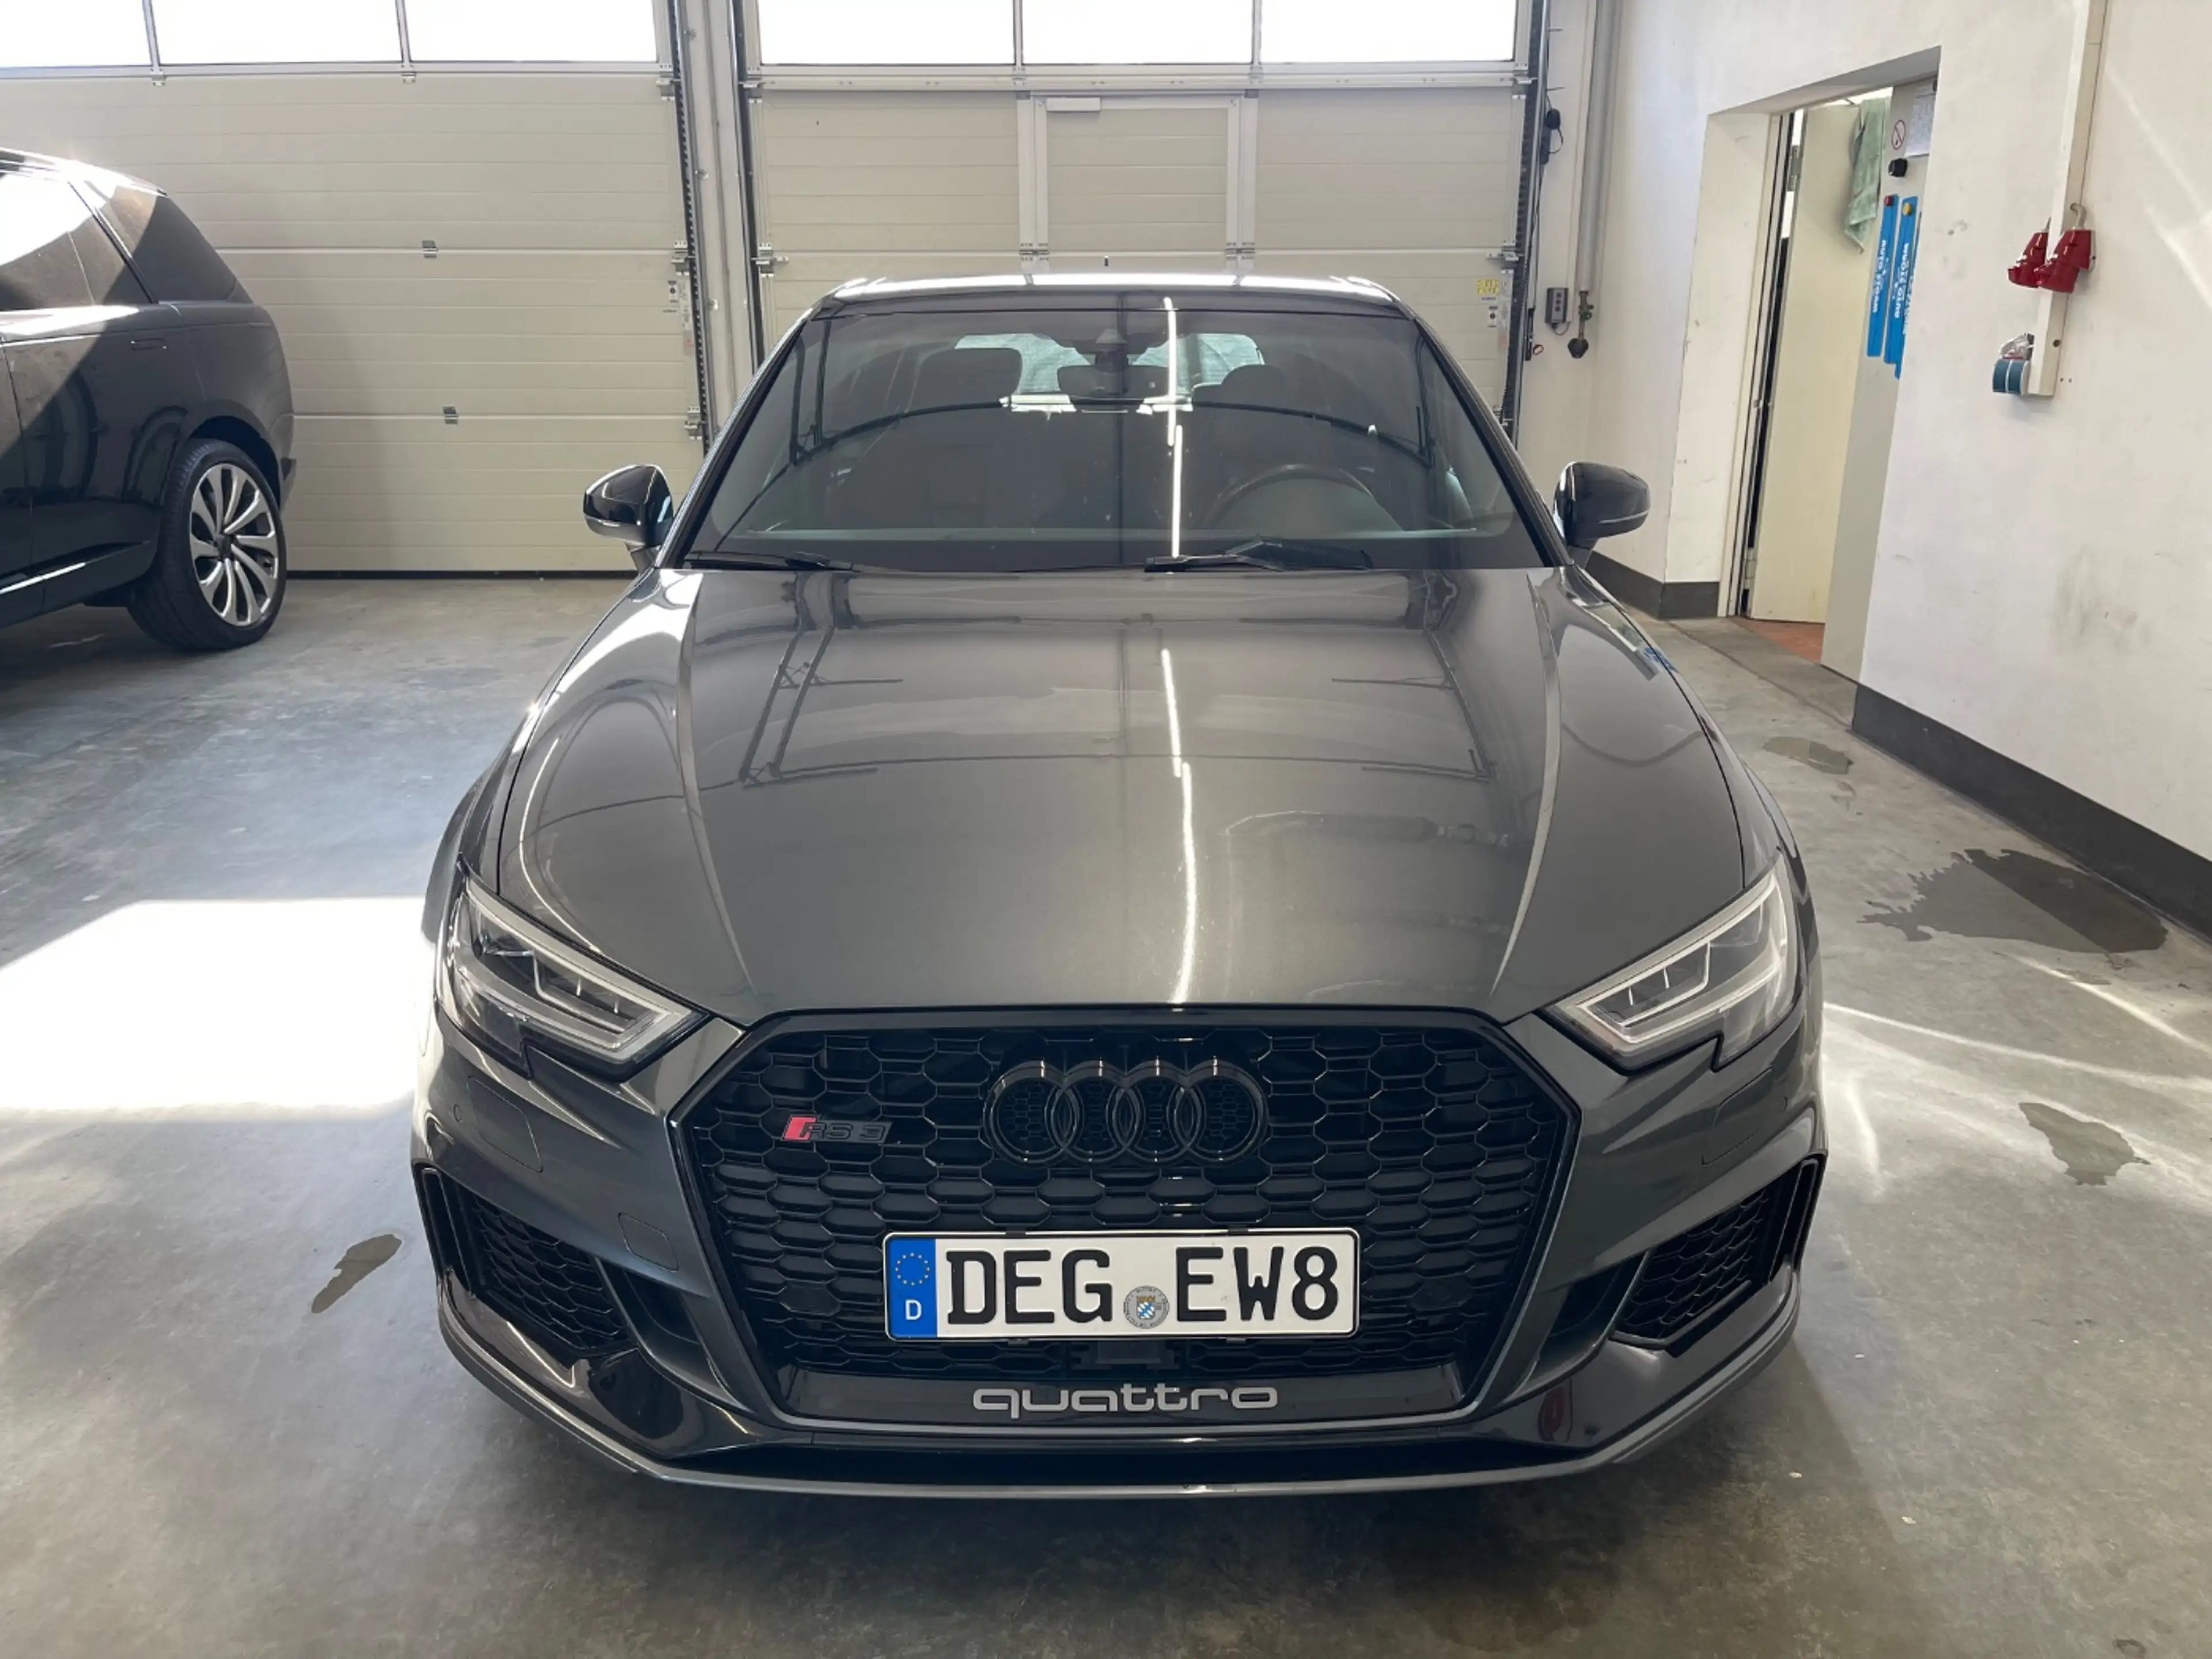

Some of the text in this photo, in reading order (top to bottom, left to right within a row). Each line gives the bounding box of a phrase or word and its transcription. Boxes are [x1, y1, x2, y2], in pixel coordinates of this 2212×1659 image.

[947, 1248, 1113, 1325] DEG
[1175, 1245, 1339, 1323] EW8
[904, 1300, 922, 1321] D
[973, 1384, 1278, 1419] quattro
